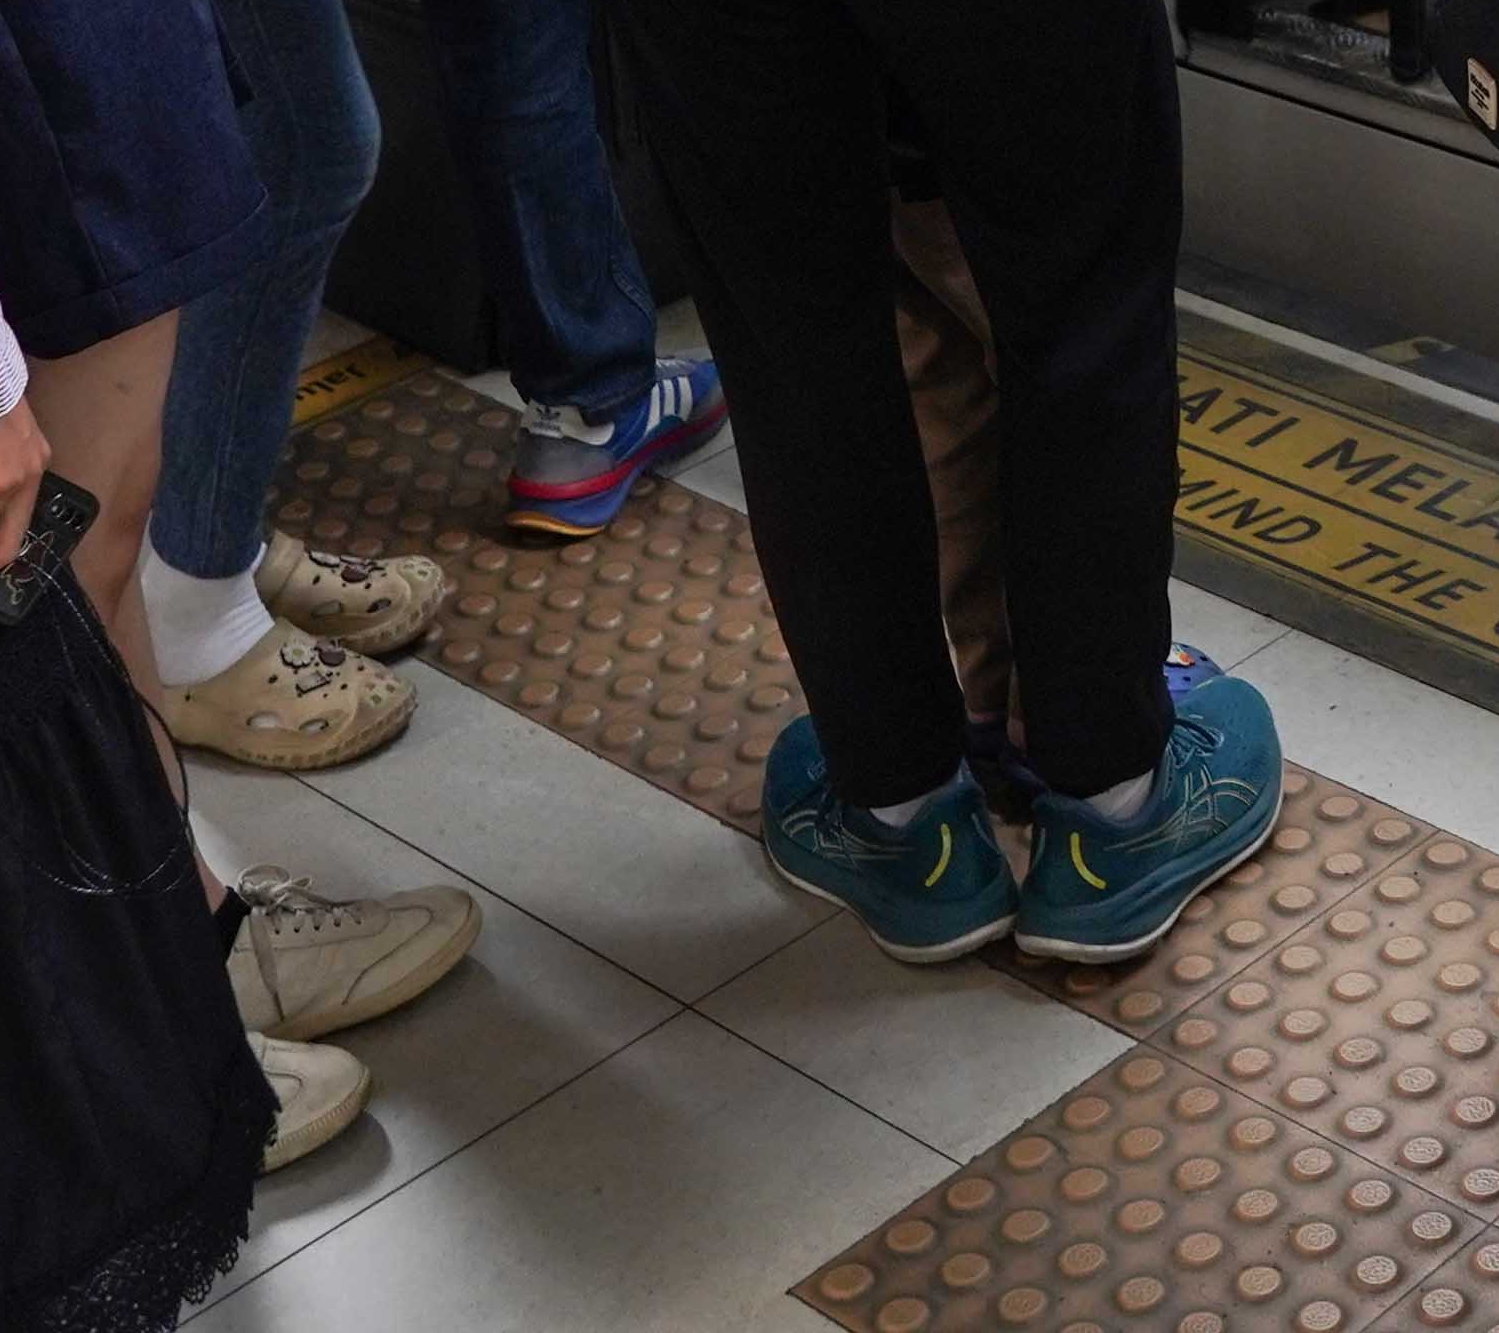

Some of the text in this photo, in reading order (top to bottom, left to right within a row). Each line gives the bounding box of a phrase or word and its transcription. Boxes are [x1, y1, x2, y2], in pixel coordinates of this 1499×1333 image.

[1178, 375, 1300, 449] ATI
[1177, 469, 1323, 545] MIND
[1332, 542, 1486, 611] THE
